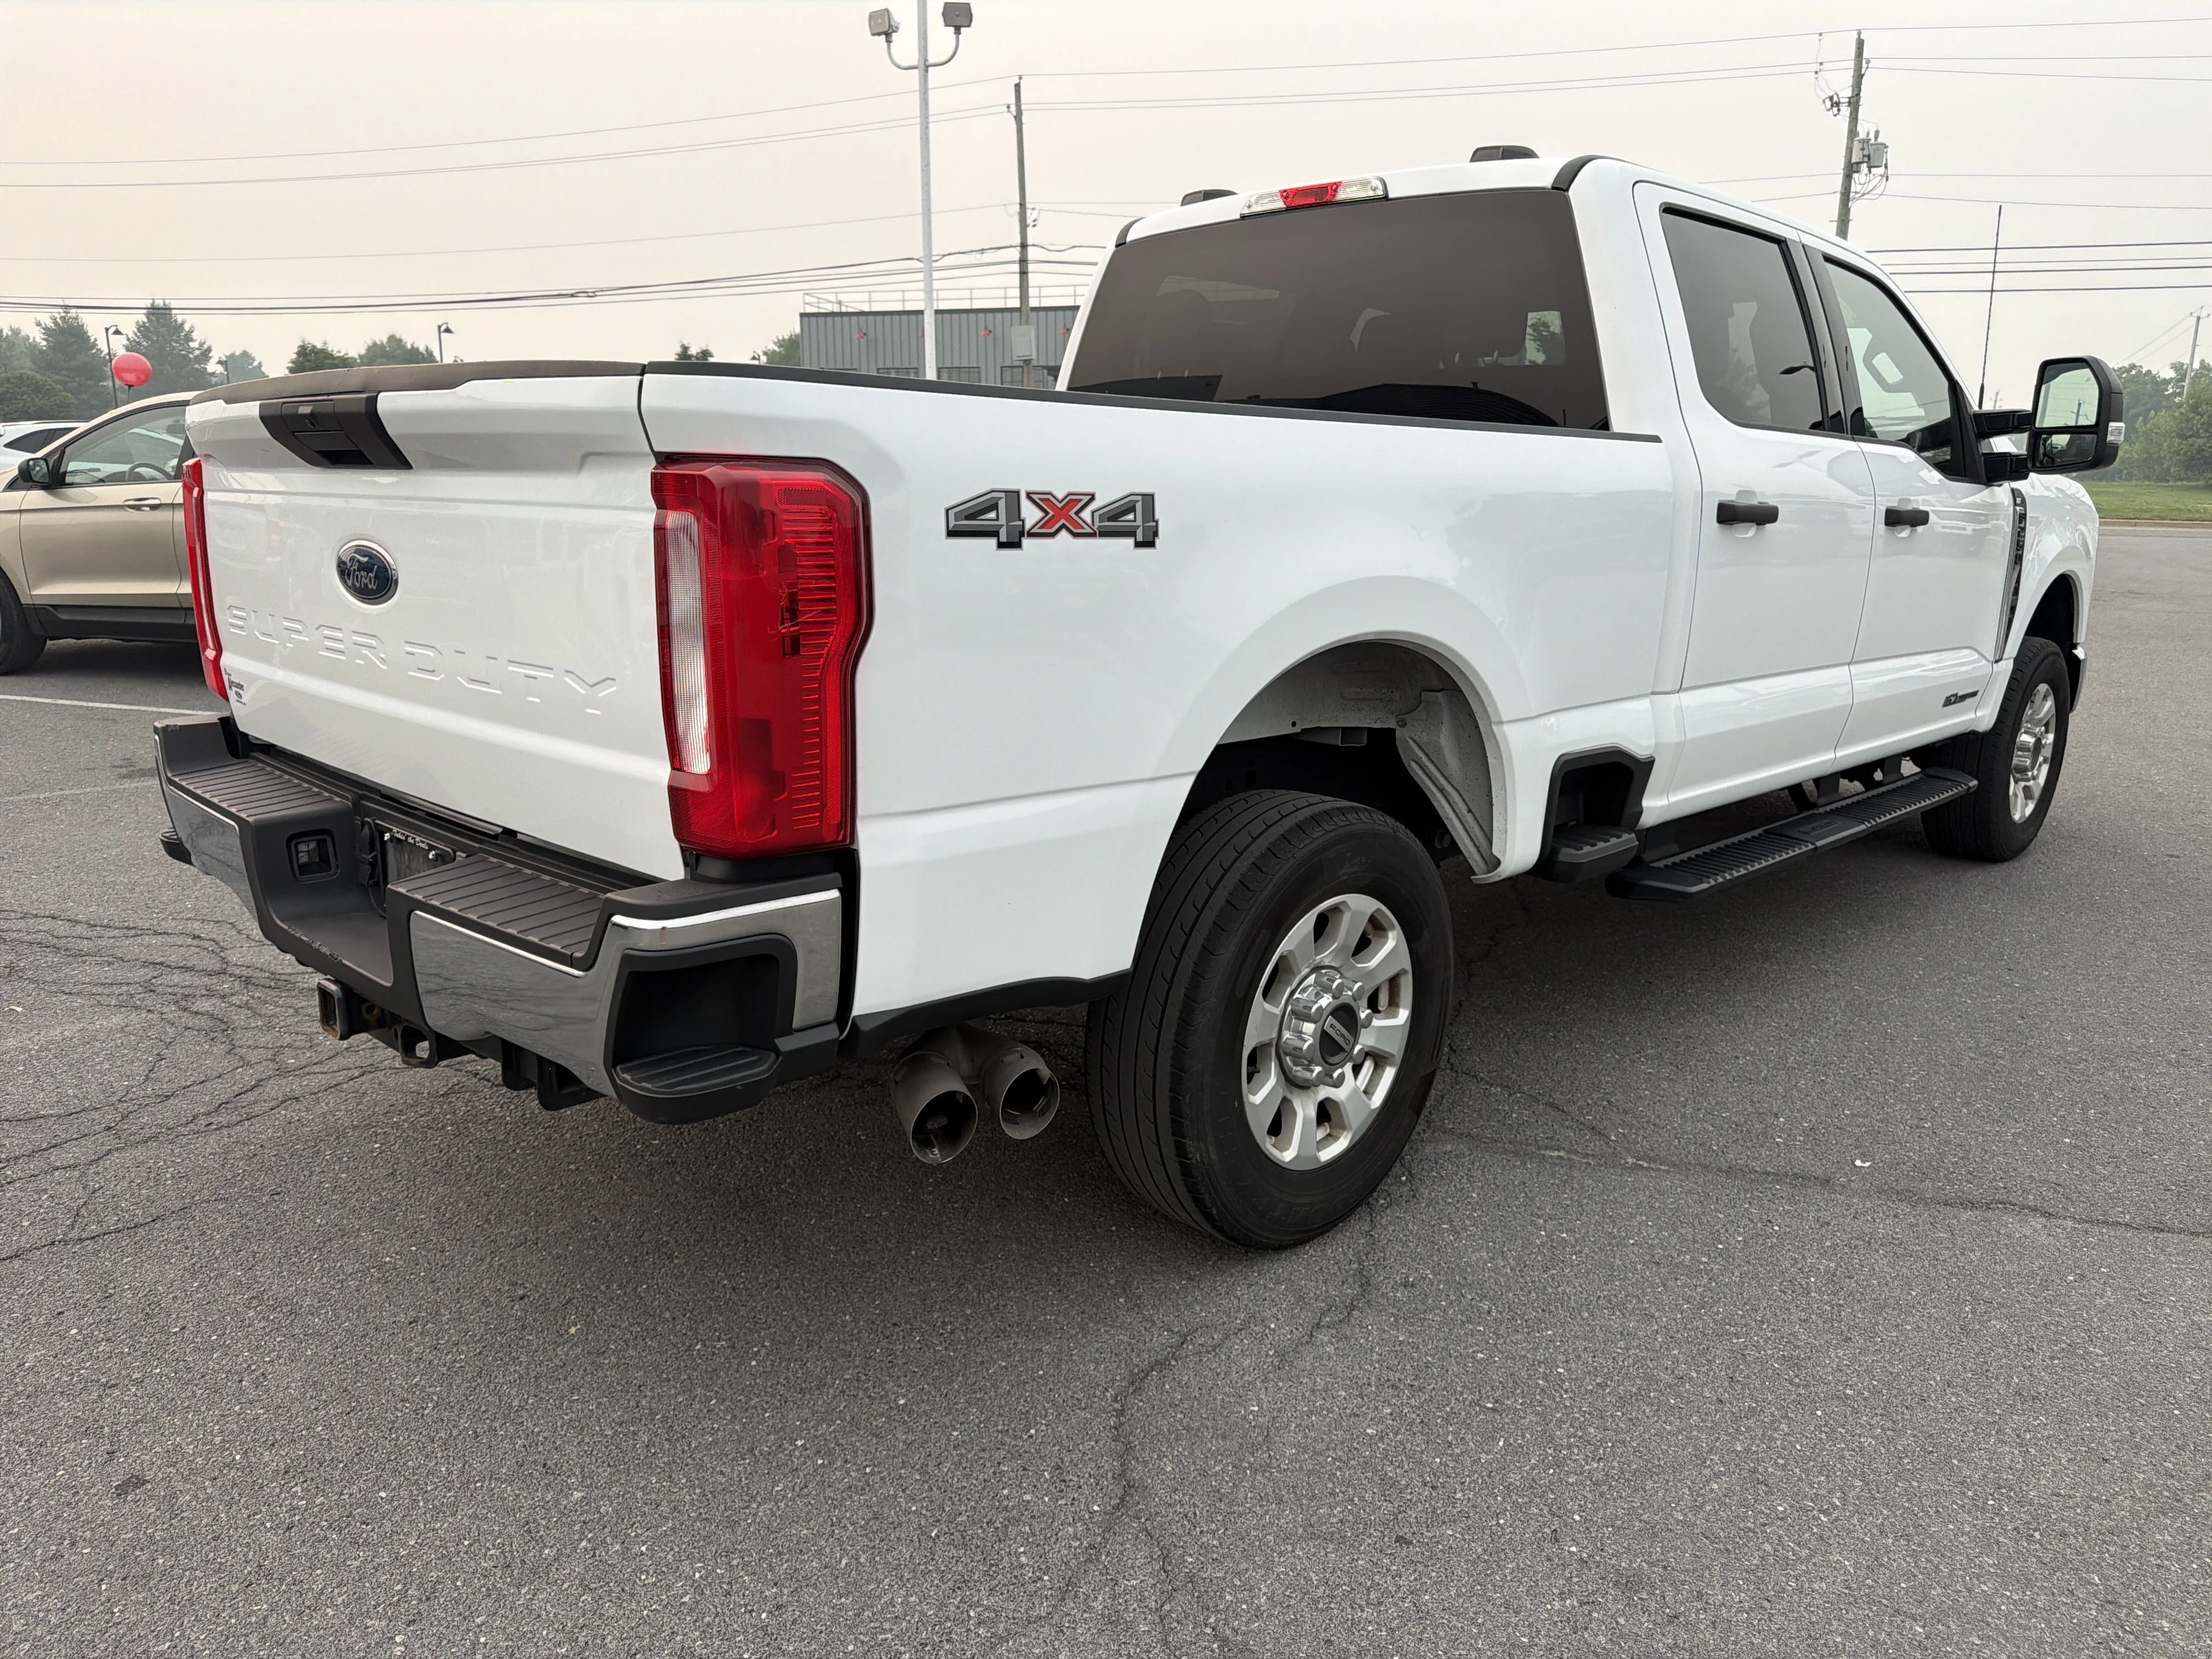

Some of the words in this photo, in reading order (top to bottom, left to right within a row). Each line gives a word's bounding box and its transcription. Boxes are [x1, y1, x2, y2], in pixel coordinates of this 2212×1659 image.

[345, 553, 378, 591] Ford
[228, 606, 387, 669] SUPER
[404, 640, 617, 715] DUTY
[1329, 1024, 1351, 1046] FORD
